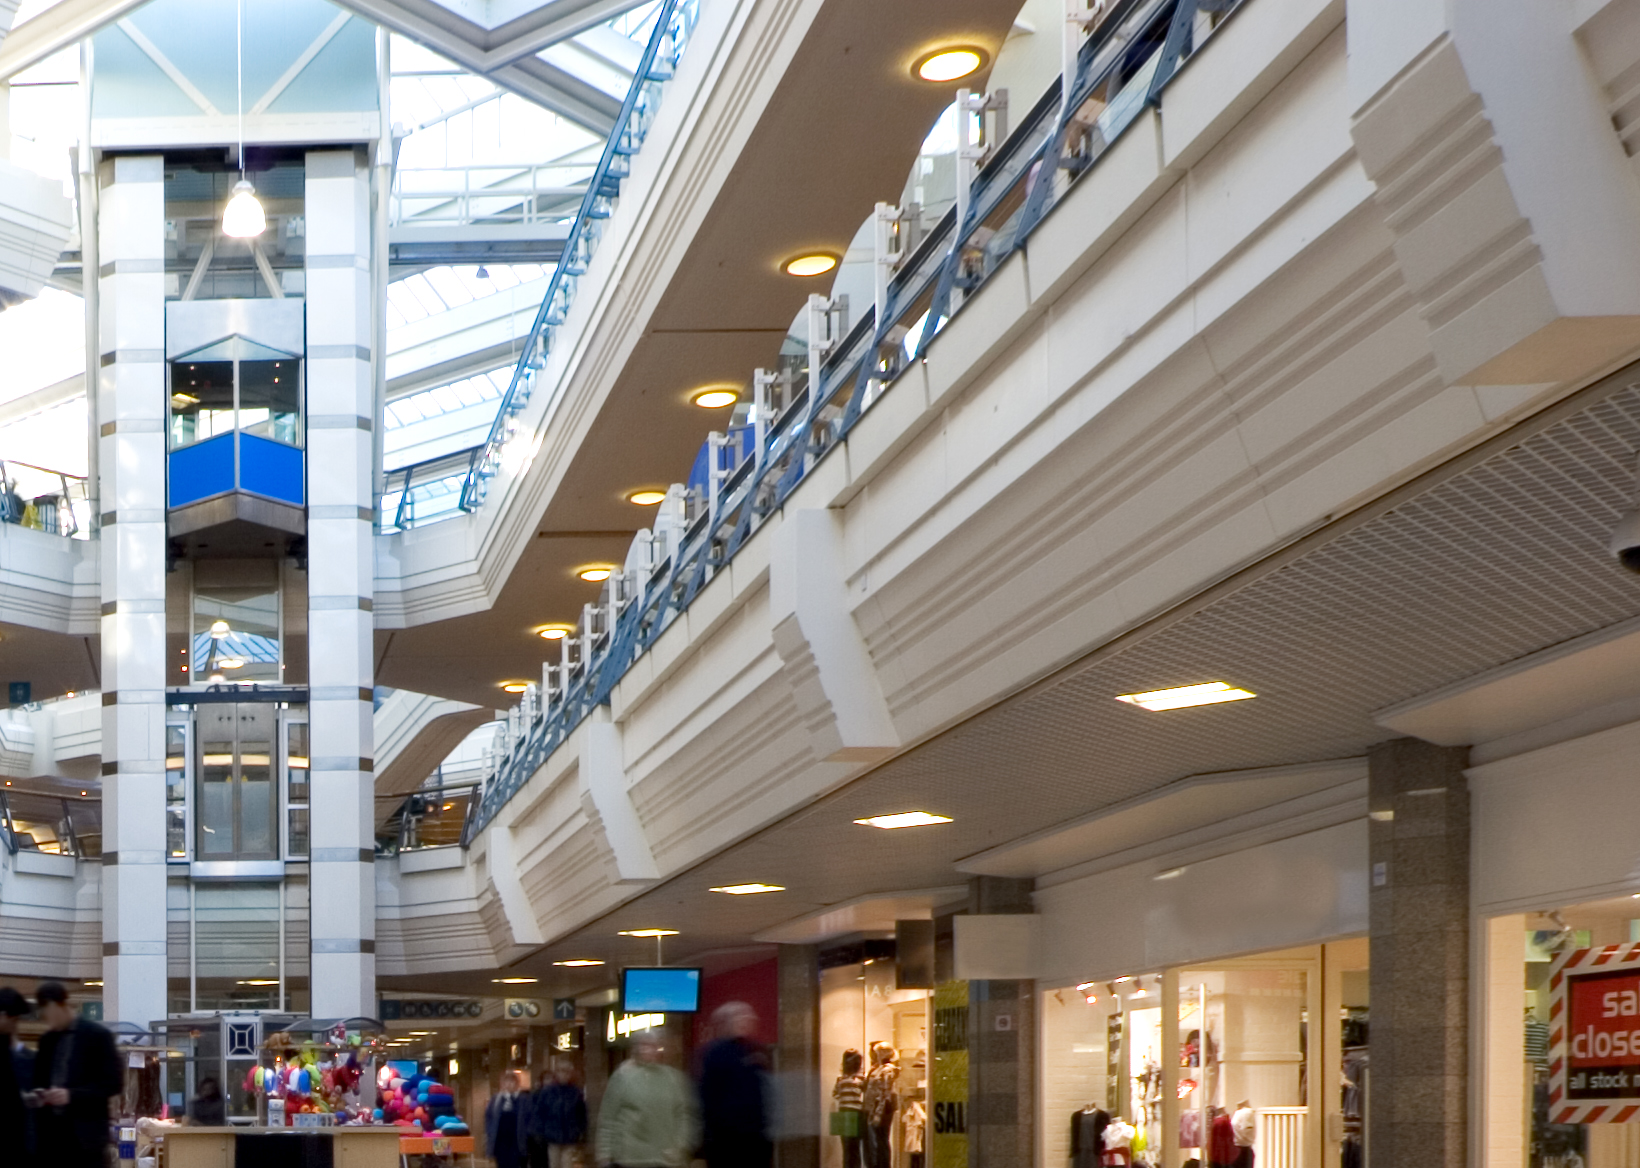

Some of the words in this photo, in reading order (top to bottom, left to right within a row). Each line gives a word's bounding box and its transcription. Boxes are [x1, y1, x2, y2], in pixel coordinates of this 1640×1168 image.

[1602, 979, 1640, 1019] sa
[1569, 1071, 1587, 1090] all
[1589, 1069, 1629, 1089] stock
[934, 1101, 969, 1134] SAL
